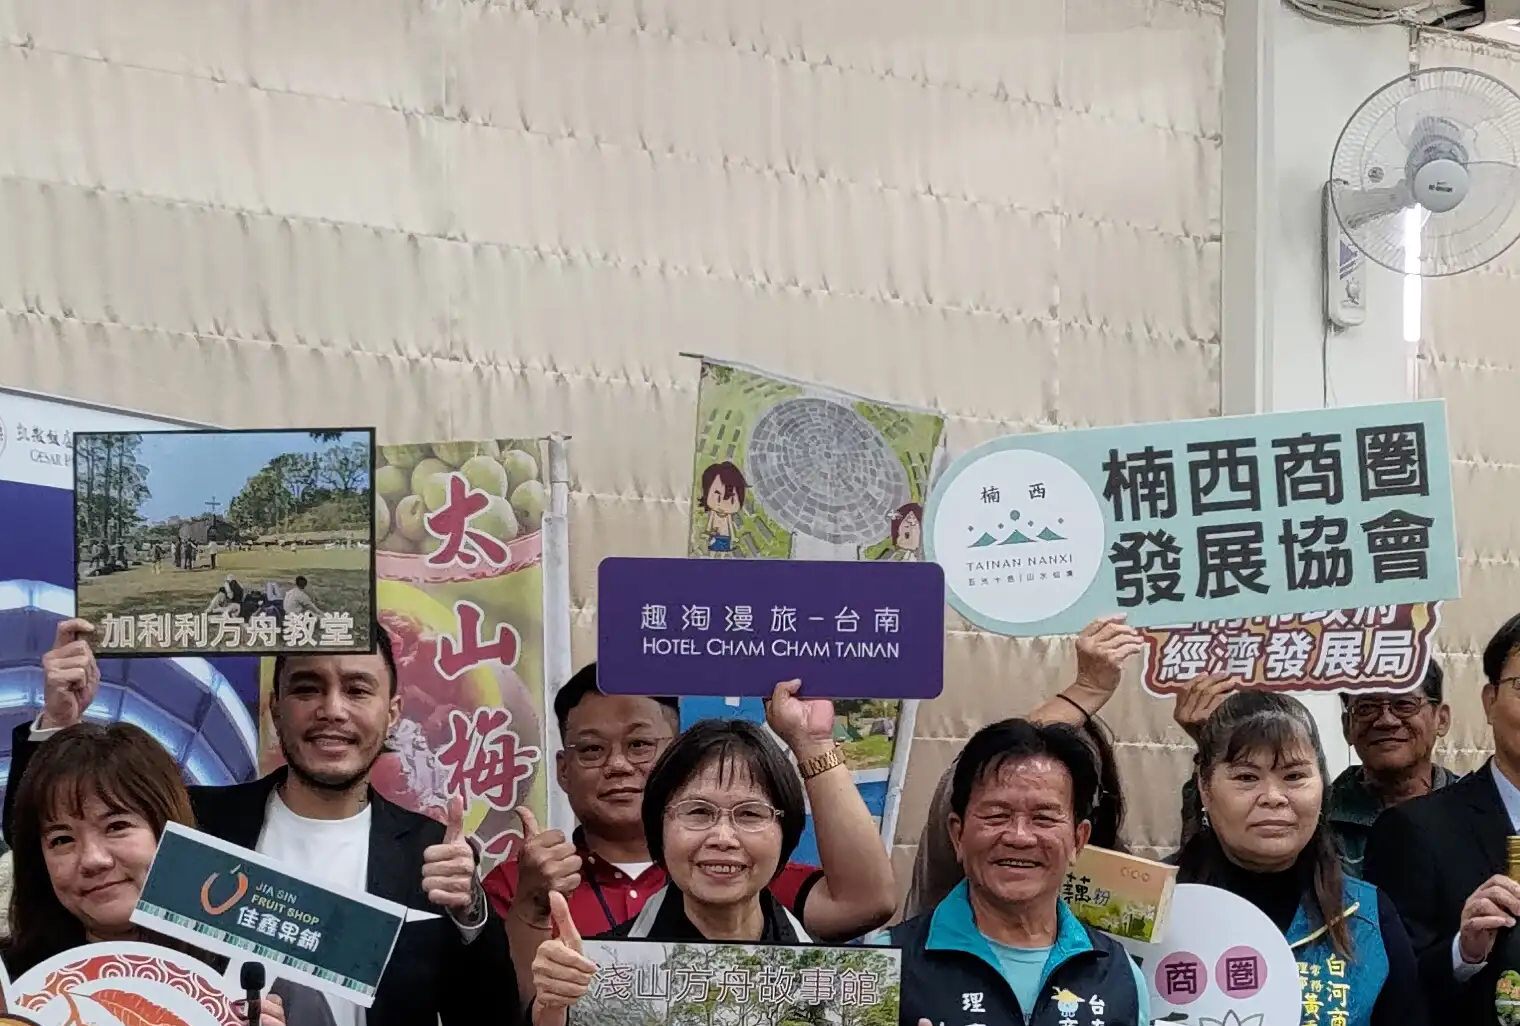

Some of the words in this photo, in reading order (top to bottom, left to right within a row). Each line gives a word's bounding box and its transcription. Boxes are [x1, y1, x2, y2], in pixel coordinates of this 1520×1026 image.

[1102, 422, 1429, 522] 楠西商圈
[967, 557, 1021, 572] TAINAN
[1028, 553, 1073, 567] NANXI
[1109, 508, 1435, 608] 發展協會
[100, 611, 357, 650] 加利利方舟教堂
[643, 638, 702, 657] HOTEL
[707, 637, 767, 658] CHAM
[770, 637, 830, 658] CHAM
[835, 639, 899, 658] TAINAN
[424, 472, 542, 872] 太山梅
[1159, 630, 1413, 681] 經濟發展局
[250, 894, 285, 914] FRUIT
[287, 907, 320, 927] SHOP
[255, 882, 274, 896] JIA
[276, 888, 298, 905] SIN
[236, 905, 322, 953] 佳鑫果鋪
[592, 961, 880, 1007] 淺山方舟故事館
[1164, 956, 1259, 995] 商圈
